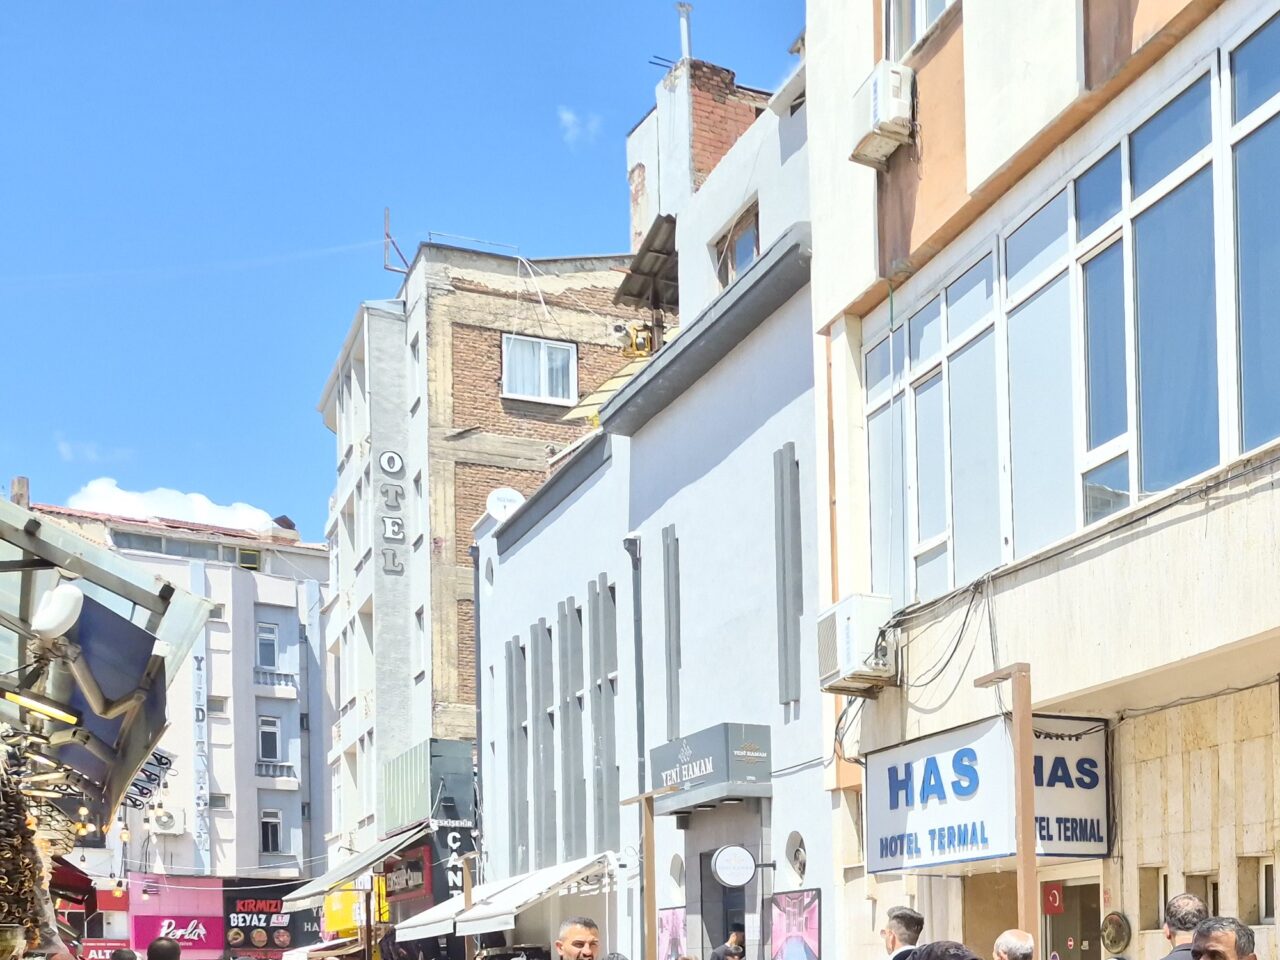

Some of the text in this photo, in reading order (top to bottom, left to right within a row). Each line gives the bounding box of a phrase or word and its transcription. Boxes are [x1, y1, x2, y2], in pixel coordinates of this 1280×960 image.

[378, 451, 405, 576] OTEL
[661, 756, 714, 787] YENİ HAMAM
[887, 747, 980, 811] HAS
[879, 820, 989, 859] HOTEL TERMAL
[1055, 816, 1104, 843] TERMAL
[229, 913, 267, 927] BEYAZ
[236, 899, 282, 913] KIRMIZI
[160, 919, 200, 941] Perla
